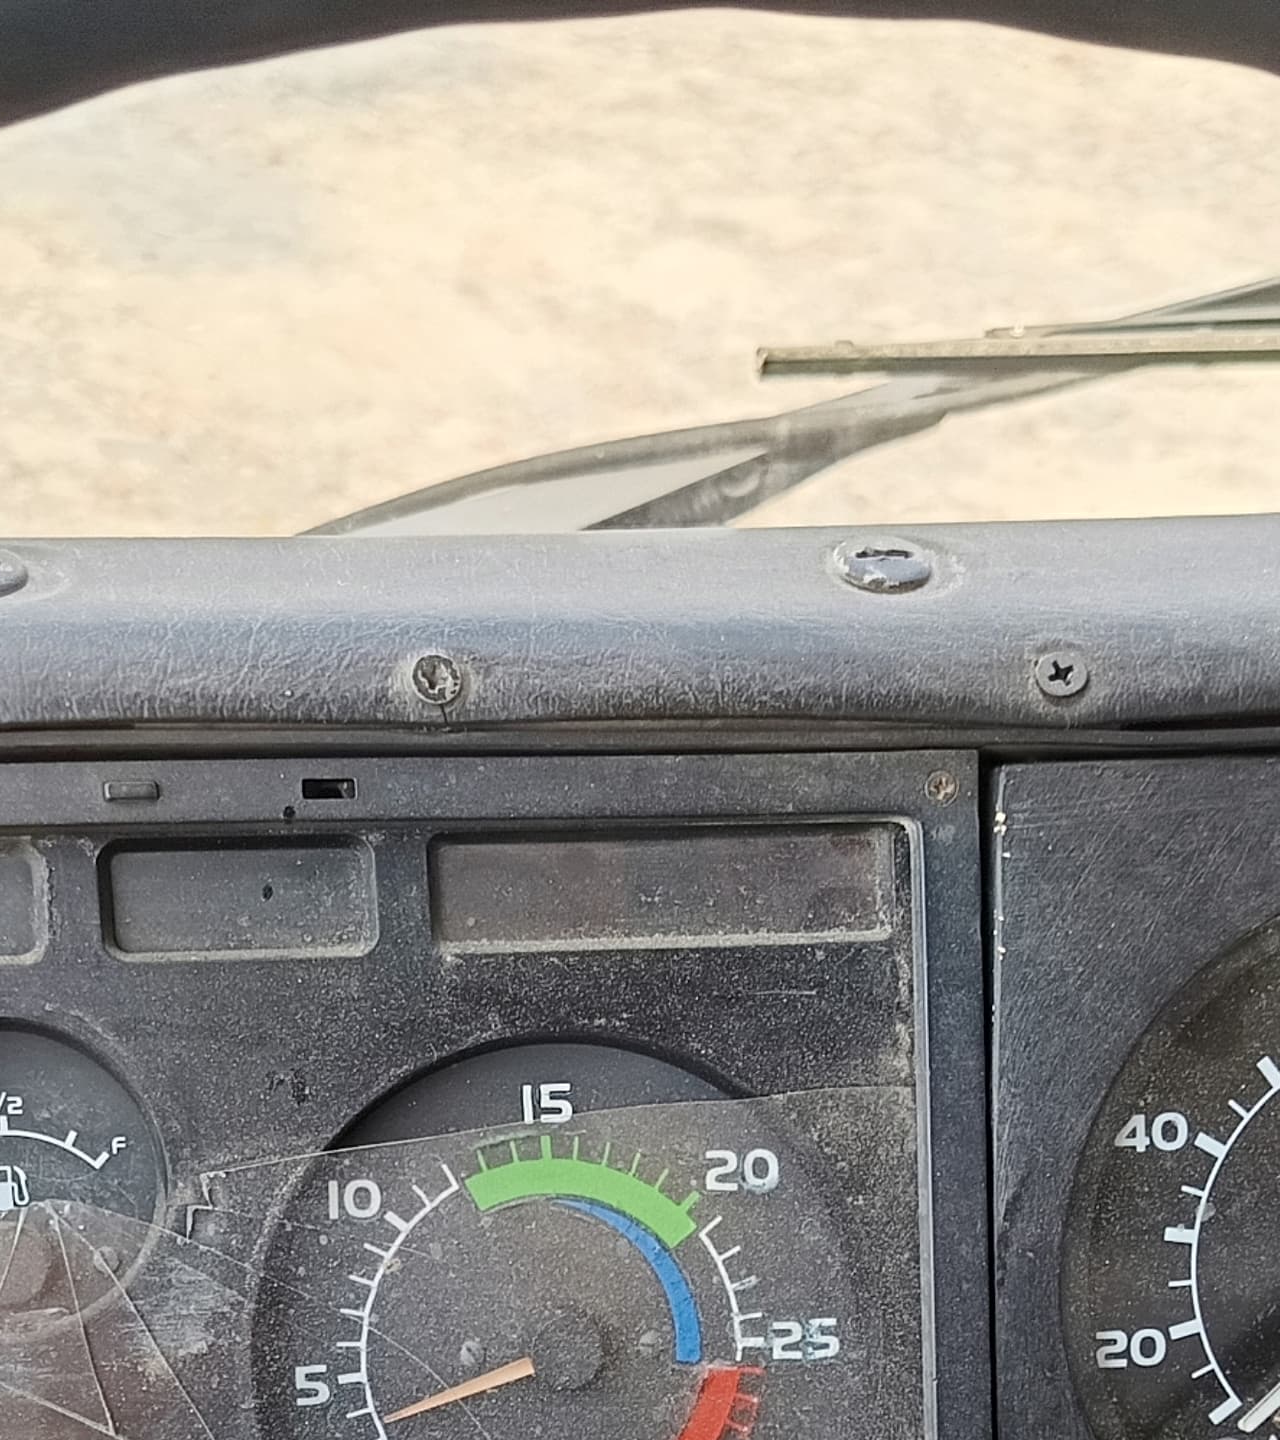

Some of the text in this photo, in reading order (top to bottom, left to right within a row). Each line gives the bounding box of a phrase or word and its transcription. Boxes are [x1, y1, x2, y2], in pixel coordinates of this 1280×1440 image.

[522, 1083, 572, 1124] 15
[112, 1136, 126, 1154] F
[1115, 1111, 1189, 1152] 40
[705, 1149, 778, 1191] 20
[327, 1180, 381, 1221] 10
[771, 1319, 840, 1360] 25
[1095, 1328, 1166, 1368] 20
[295, 1365, 331, 1406] 5
